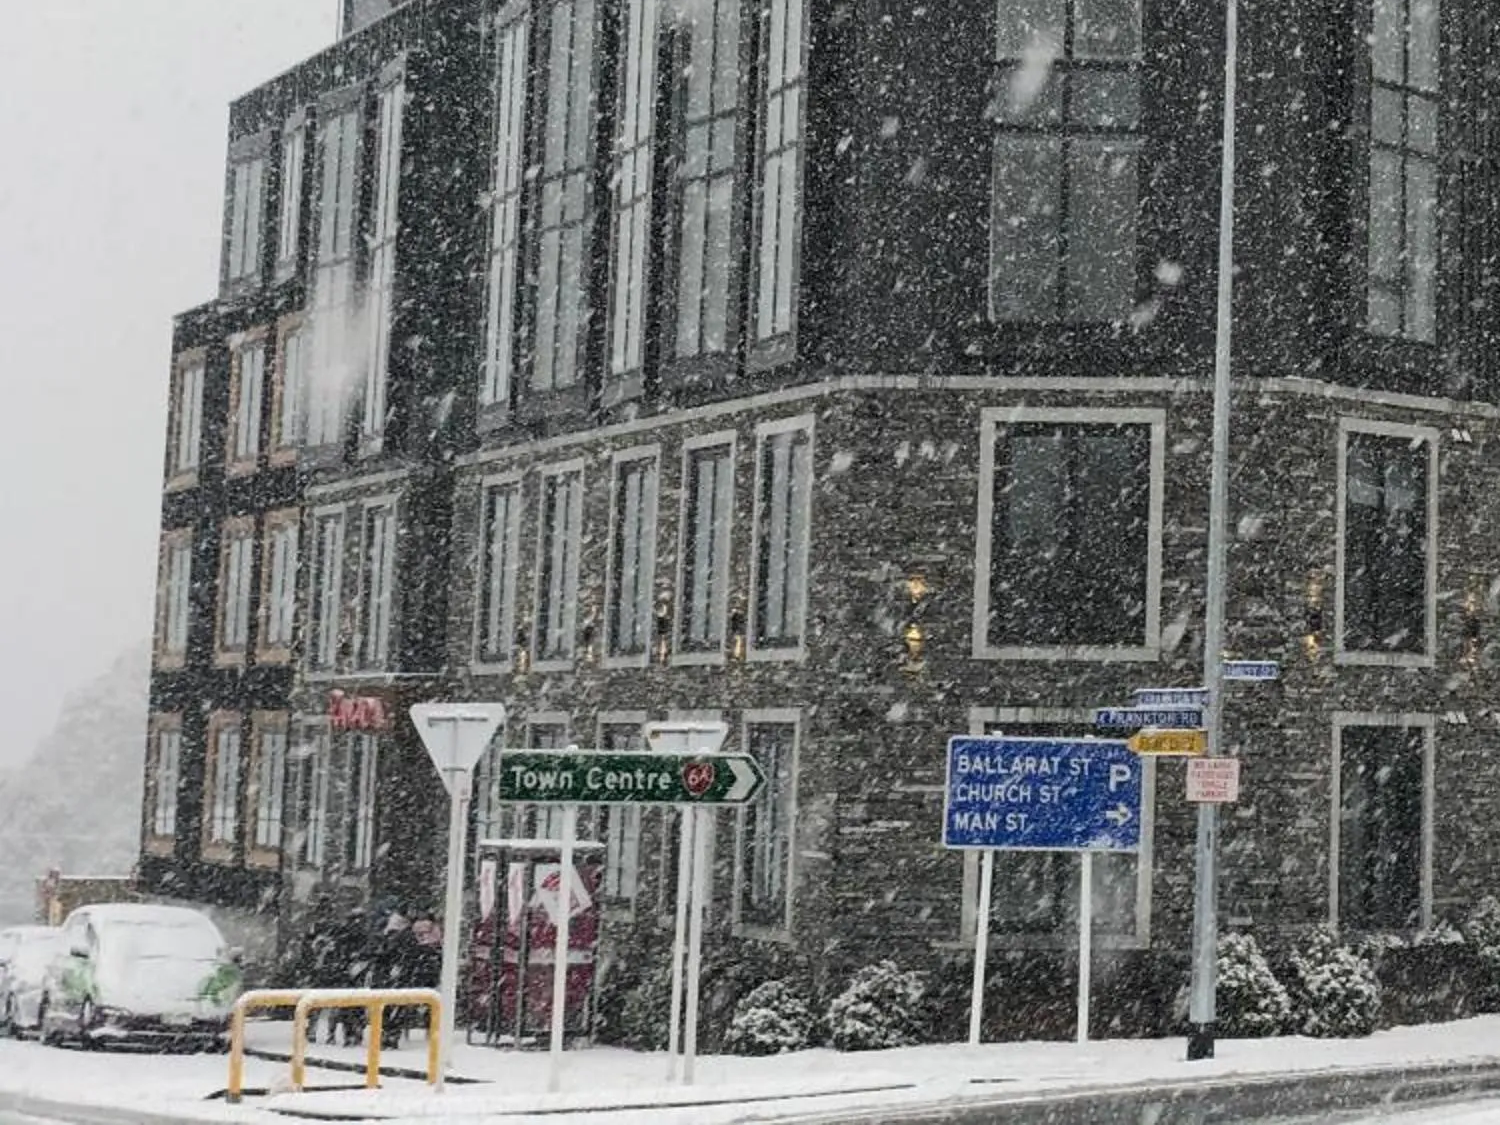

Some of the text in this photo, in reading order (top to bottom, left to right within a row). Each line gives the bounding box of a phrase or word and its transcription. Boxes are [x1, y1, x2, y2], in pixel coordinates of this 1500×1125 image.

[956, 755, 1093, 776] BALLARAT ST
[511, 765, 673, 791] Town Centre
[1108, 764, 1132, 793] P
[956, 783, 1063, 804] CHURCH ST
[954, 811, 1029, 832] MAN ST
